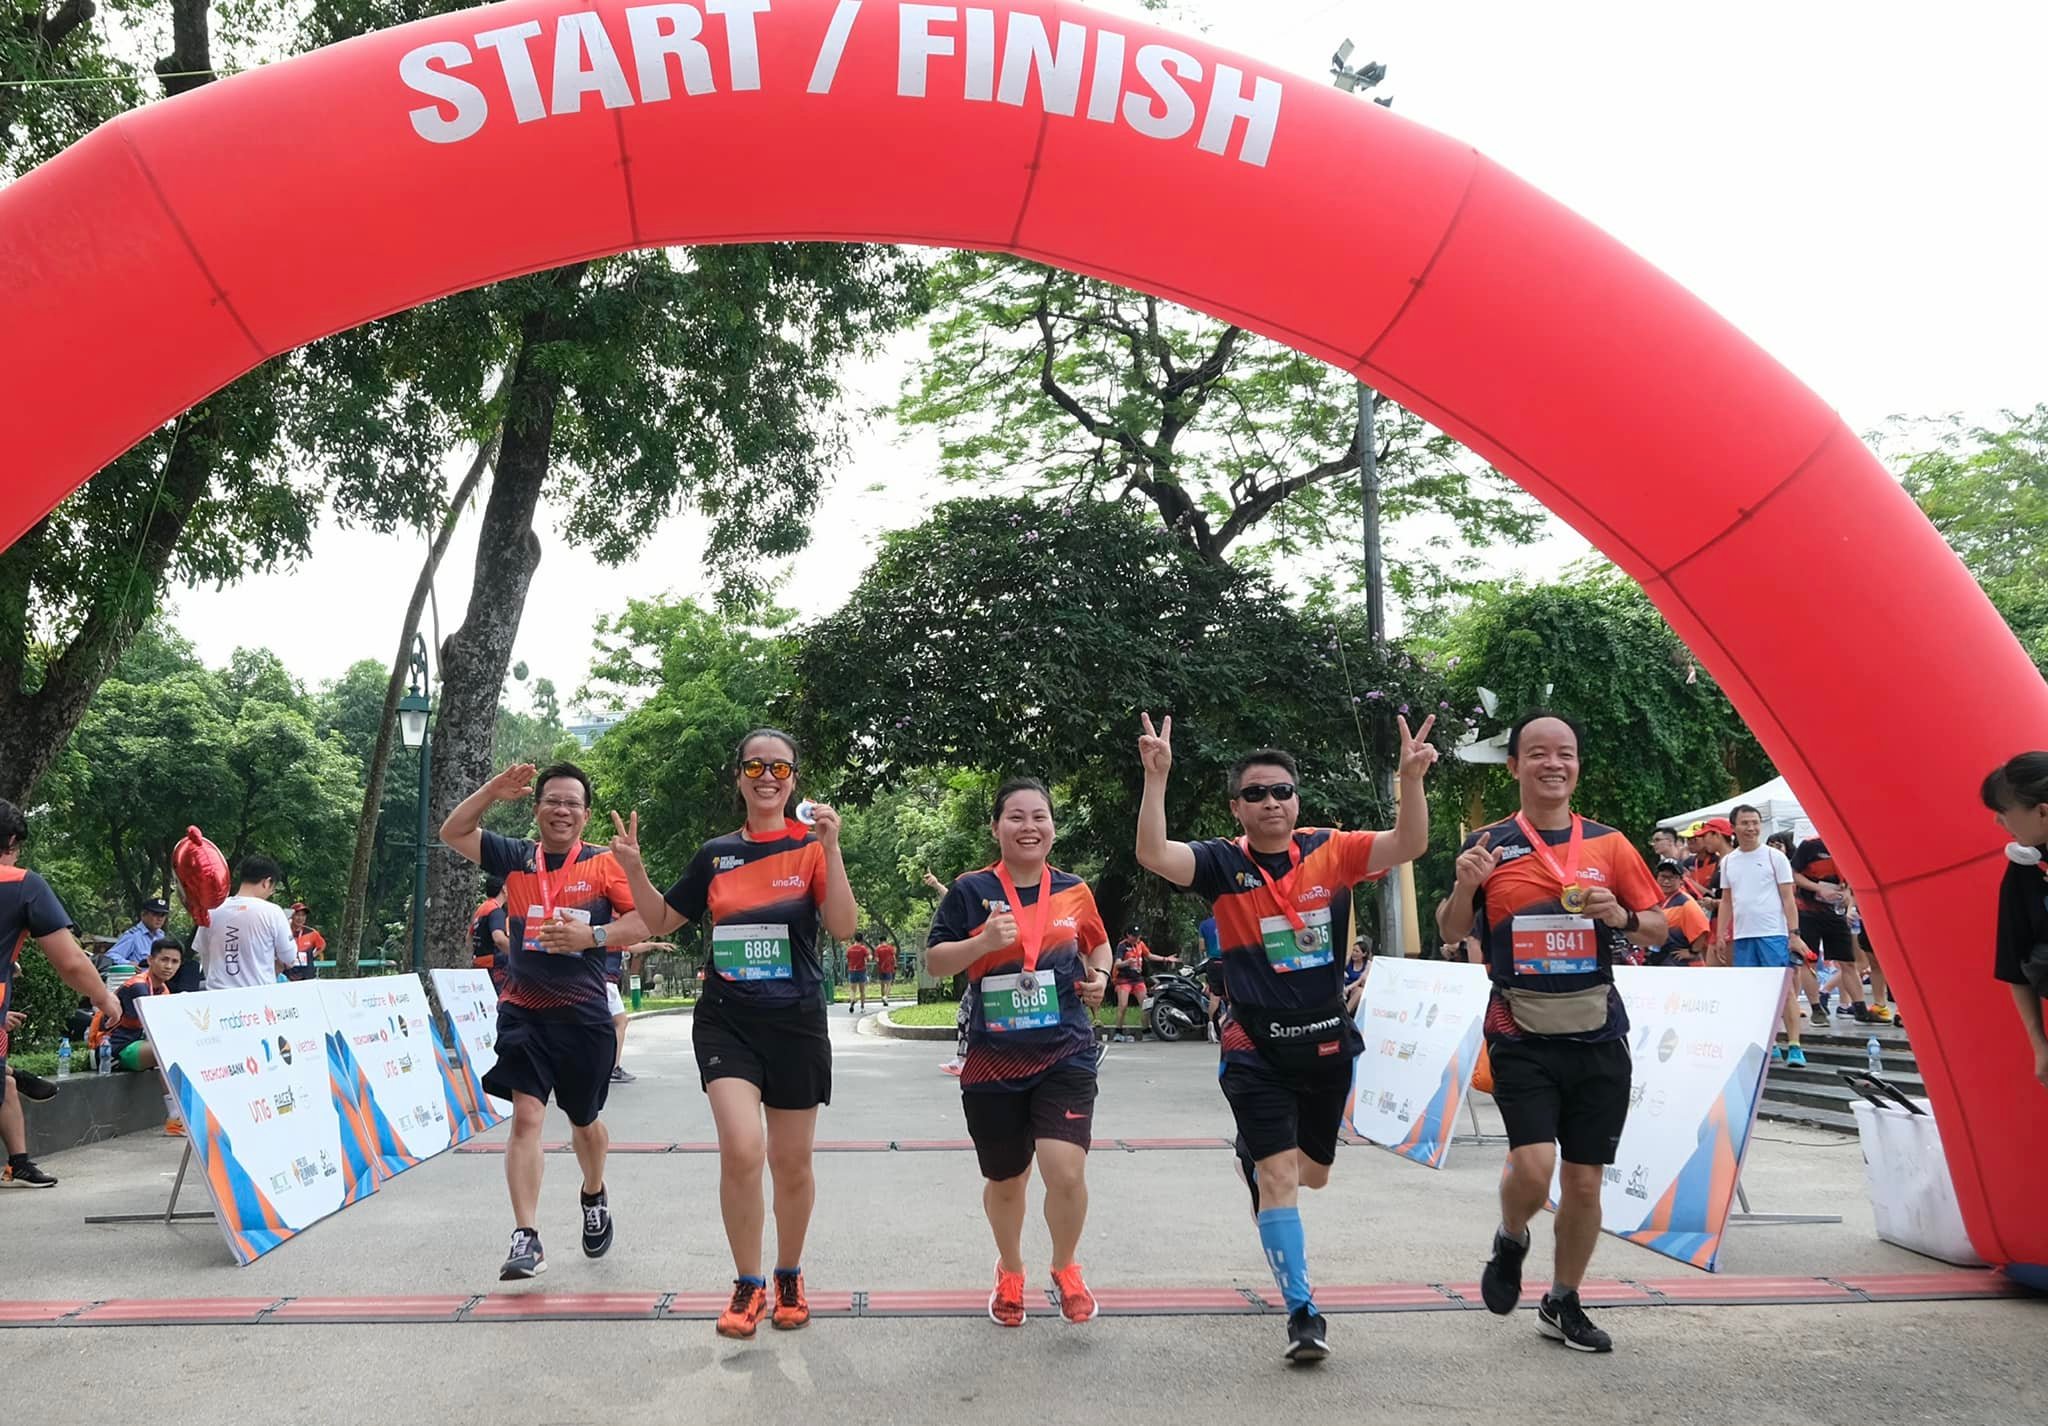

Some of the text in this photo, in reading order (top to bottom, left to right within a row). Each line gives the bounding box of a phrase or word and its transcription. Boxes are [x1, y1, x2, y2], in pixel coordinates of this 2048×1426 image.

[399, 0, 1282, 168] START / FINISH
[225, 926, 240, 976] CREW
[745, 940, 780, 959] 6884
[1546, 931, 1584, 951] 9641
[1681, 999, 1720, 1014] HUAWEI
[219, 1007, 299, 1030] mobifone HUAWEI
[1270, 1016, 1341, 1039] Supreme
[200, 1062, 246, 1082] TECHCOMBANK
